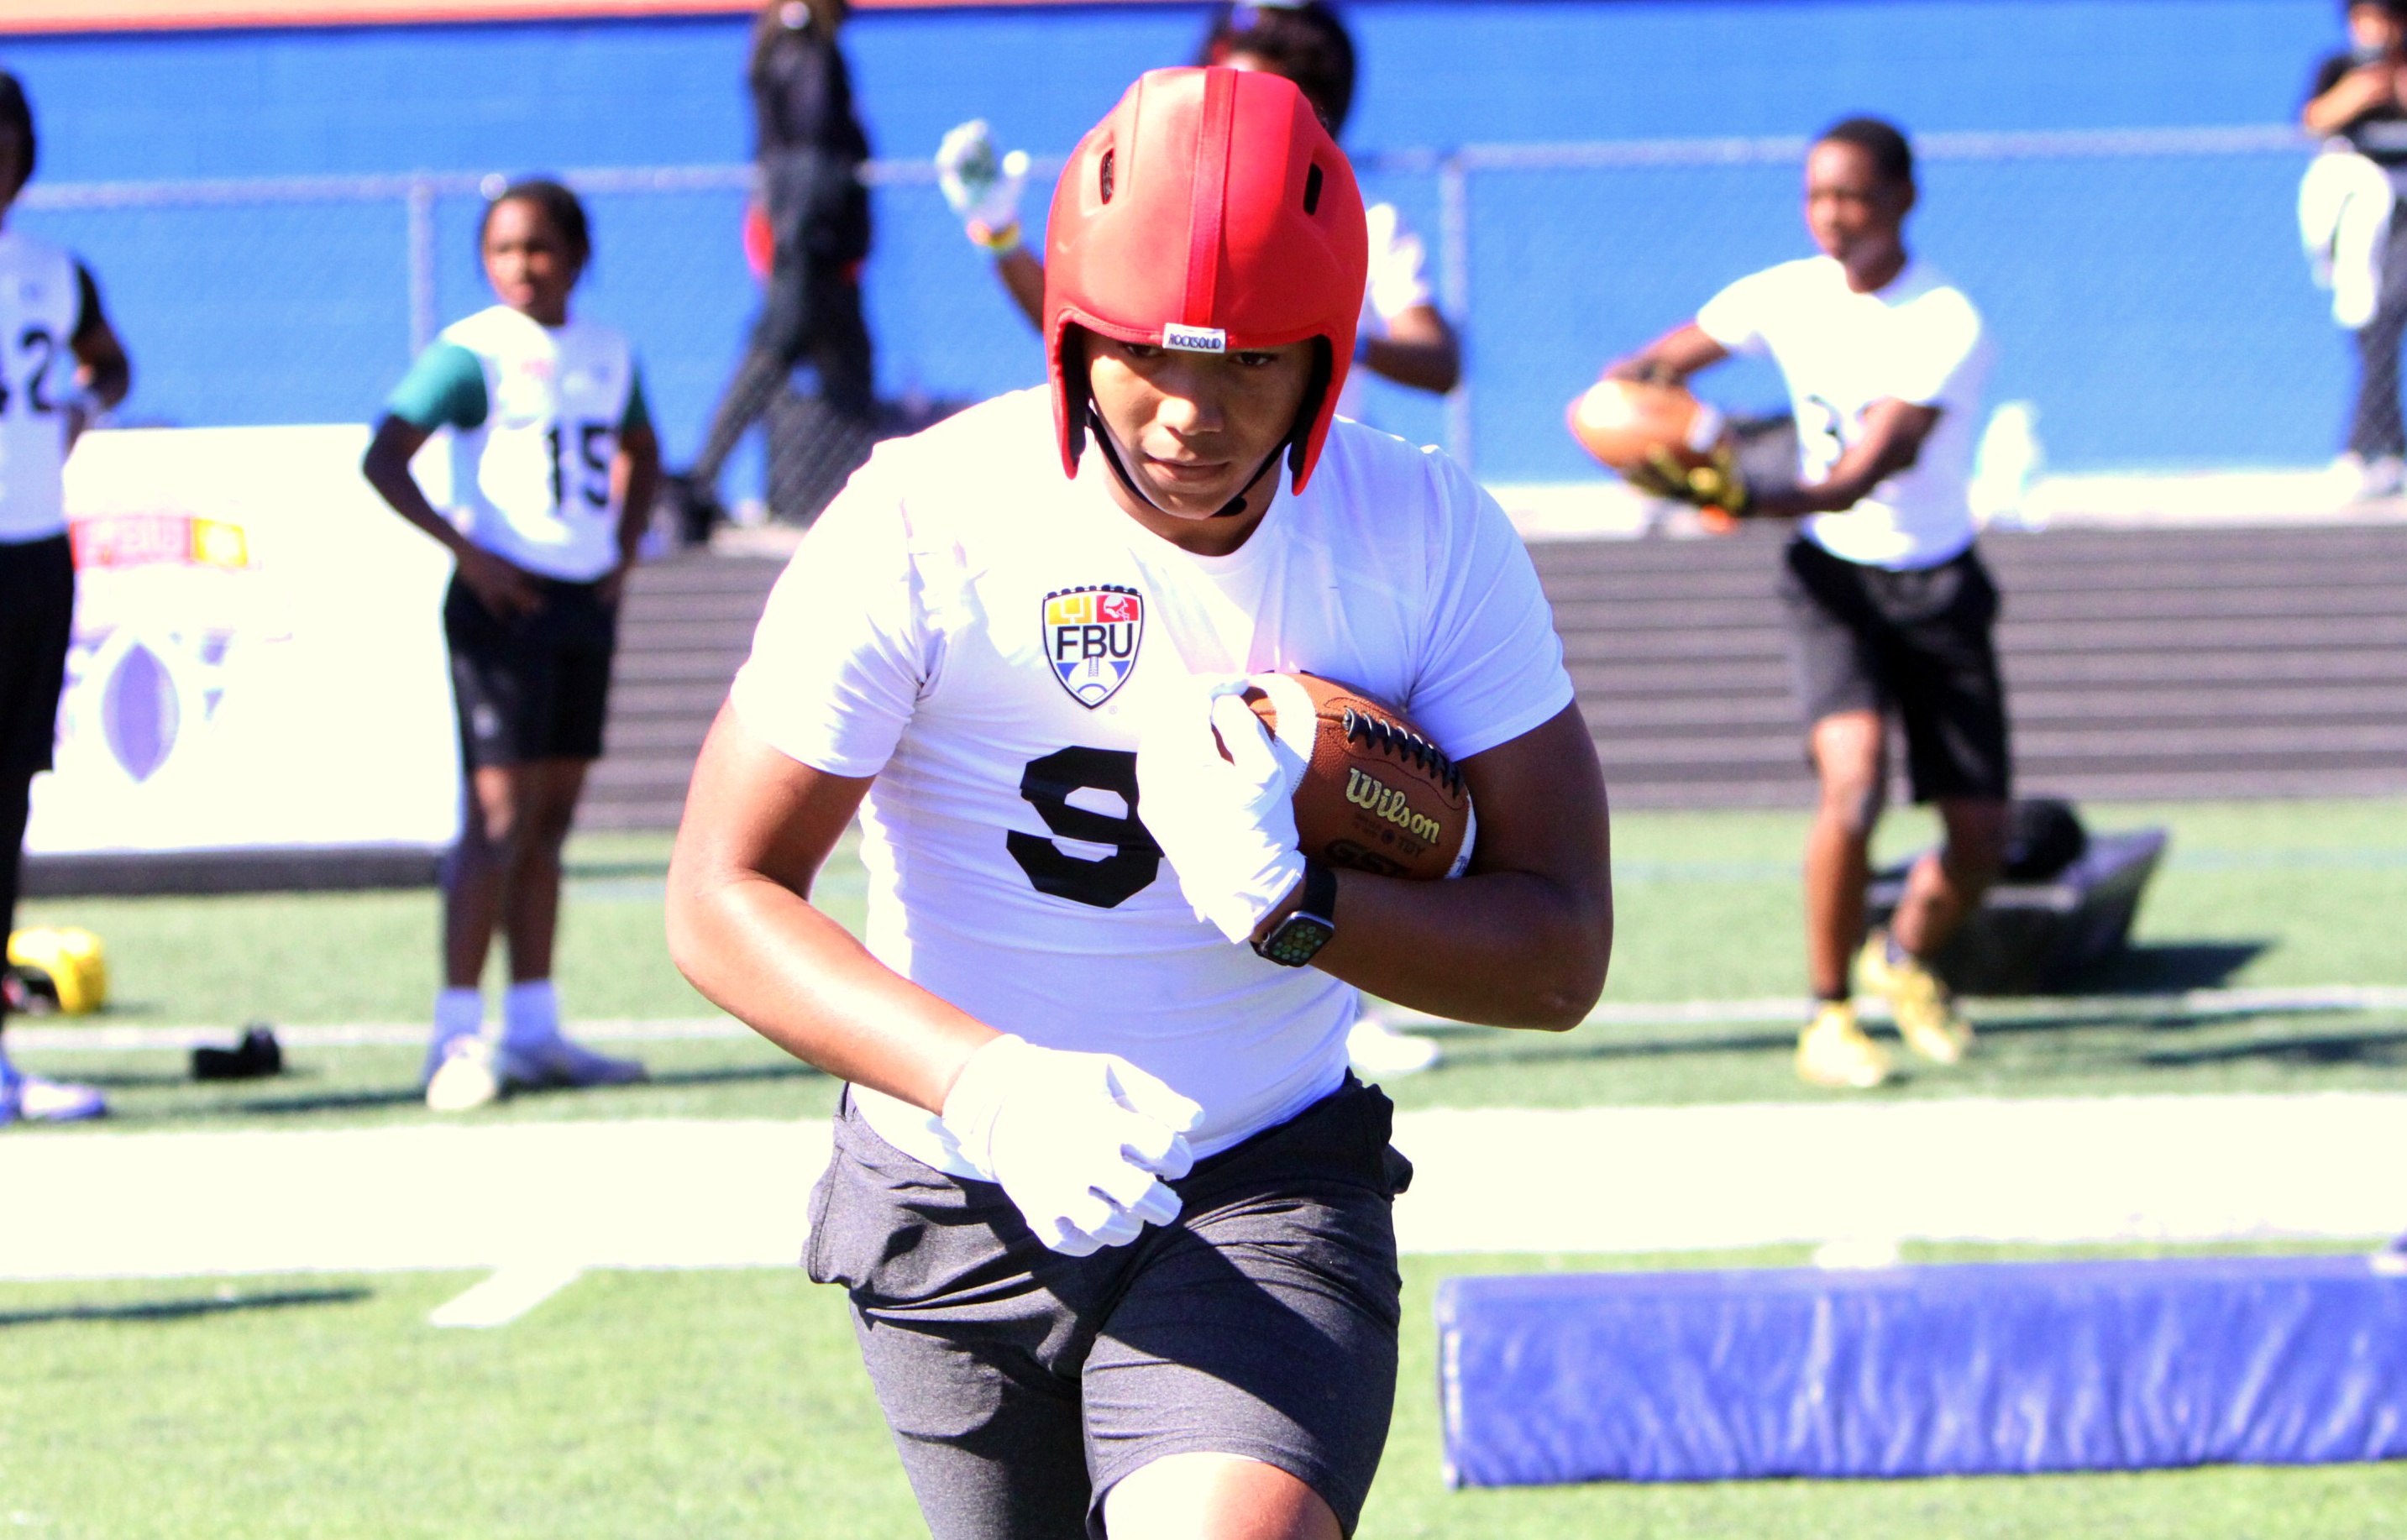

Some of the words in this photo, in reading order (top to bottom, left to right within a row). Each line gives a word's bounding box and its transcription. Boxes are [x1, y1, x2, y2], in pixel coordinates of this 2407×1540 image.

[547, 424, 610, 509] 15
[1056, 622, 1133, 661] FBU
[1345, 767, 1440, 844] Wilson
